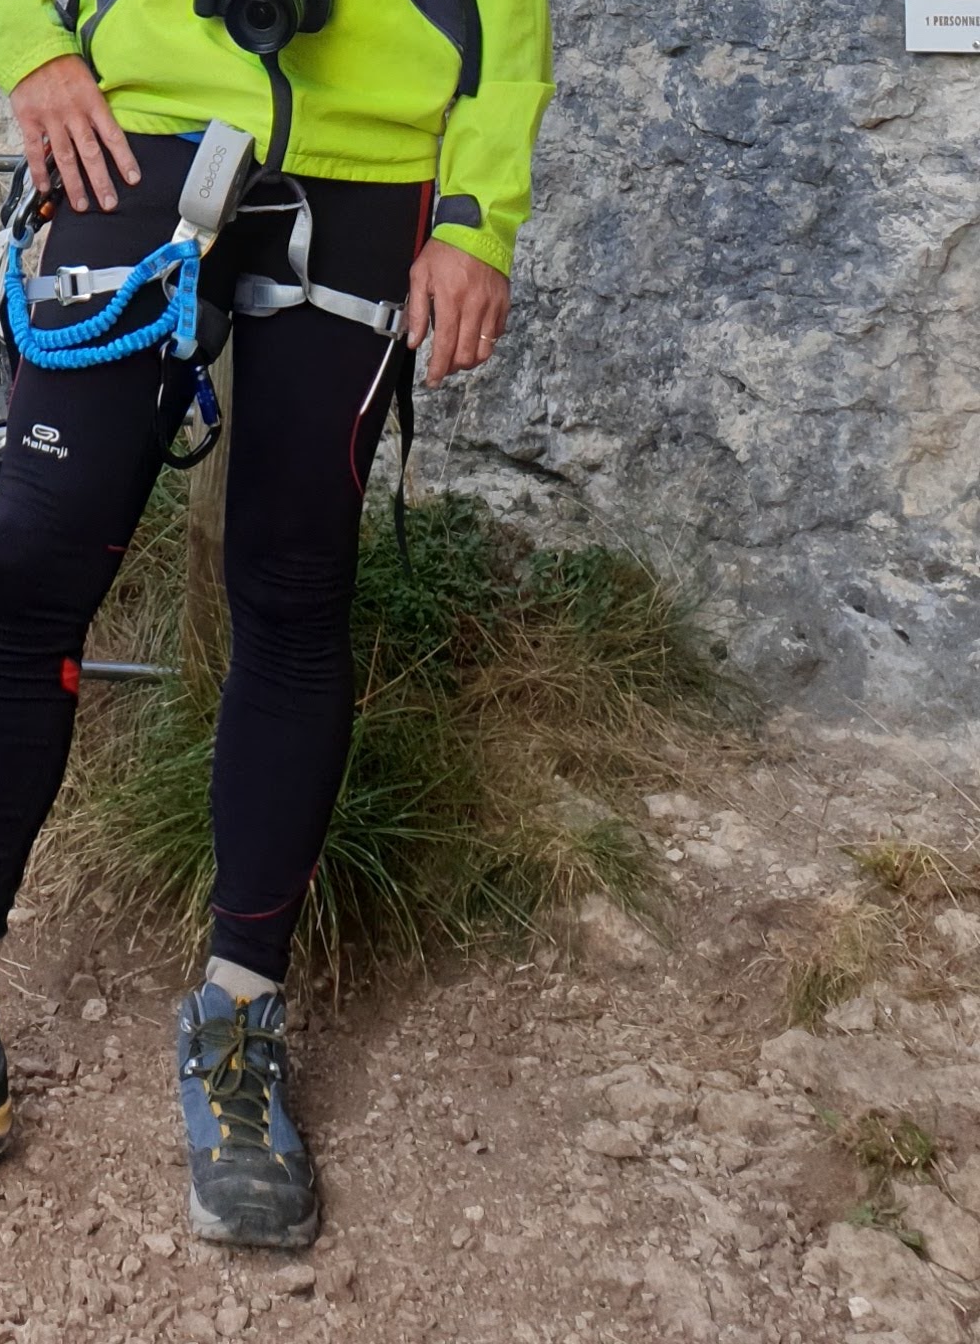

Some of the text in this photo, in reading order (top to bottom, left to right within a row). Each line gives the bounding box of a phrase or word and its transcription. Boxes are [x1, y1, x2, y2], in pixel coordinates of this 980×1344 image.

[925, 15, 980, 27] 1 PERSONNE
[199, 145, 227, 199] SCORPIO
